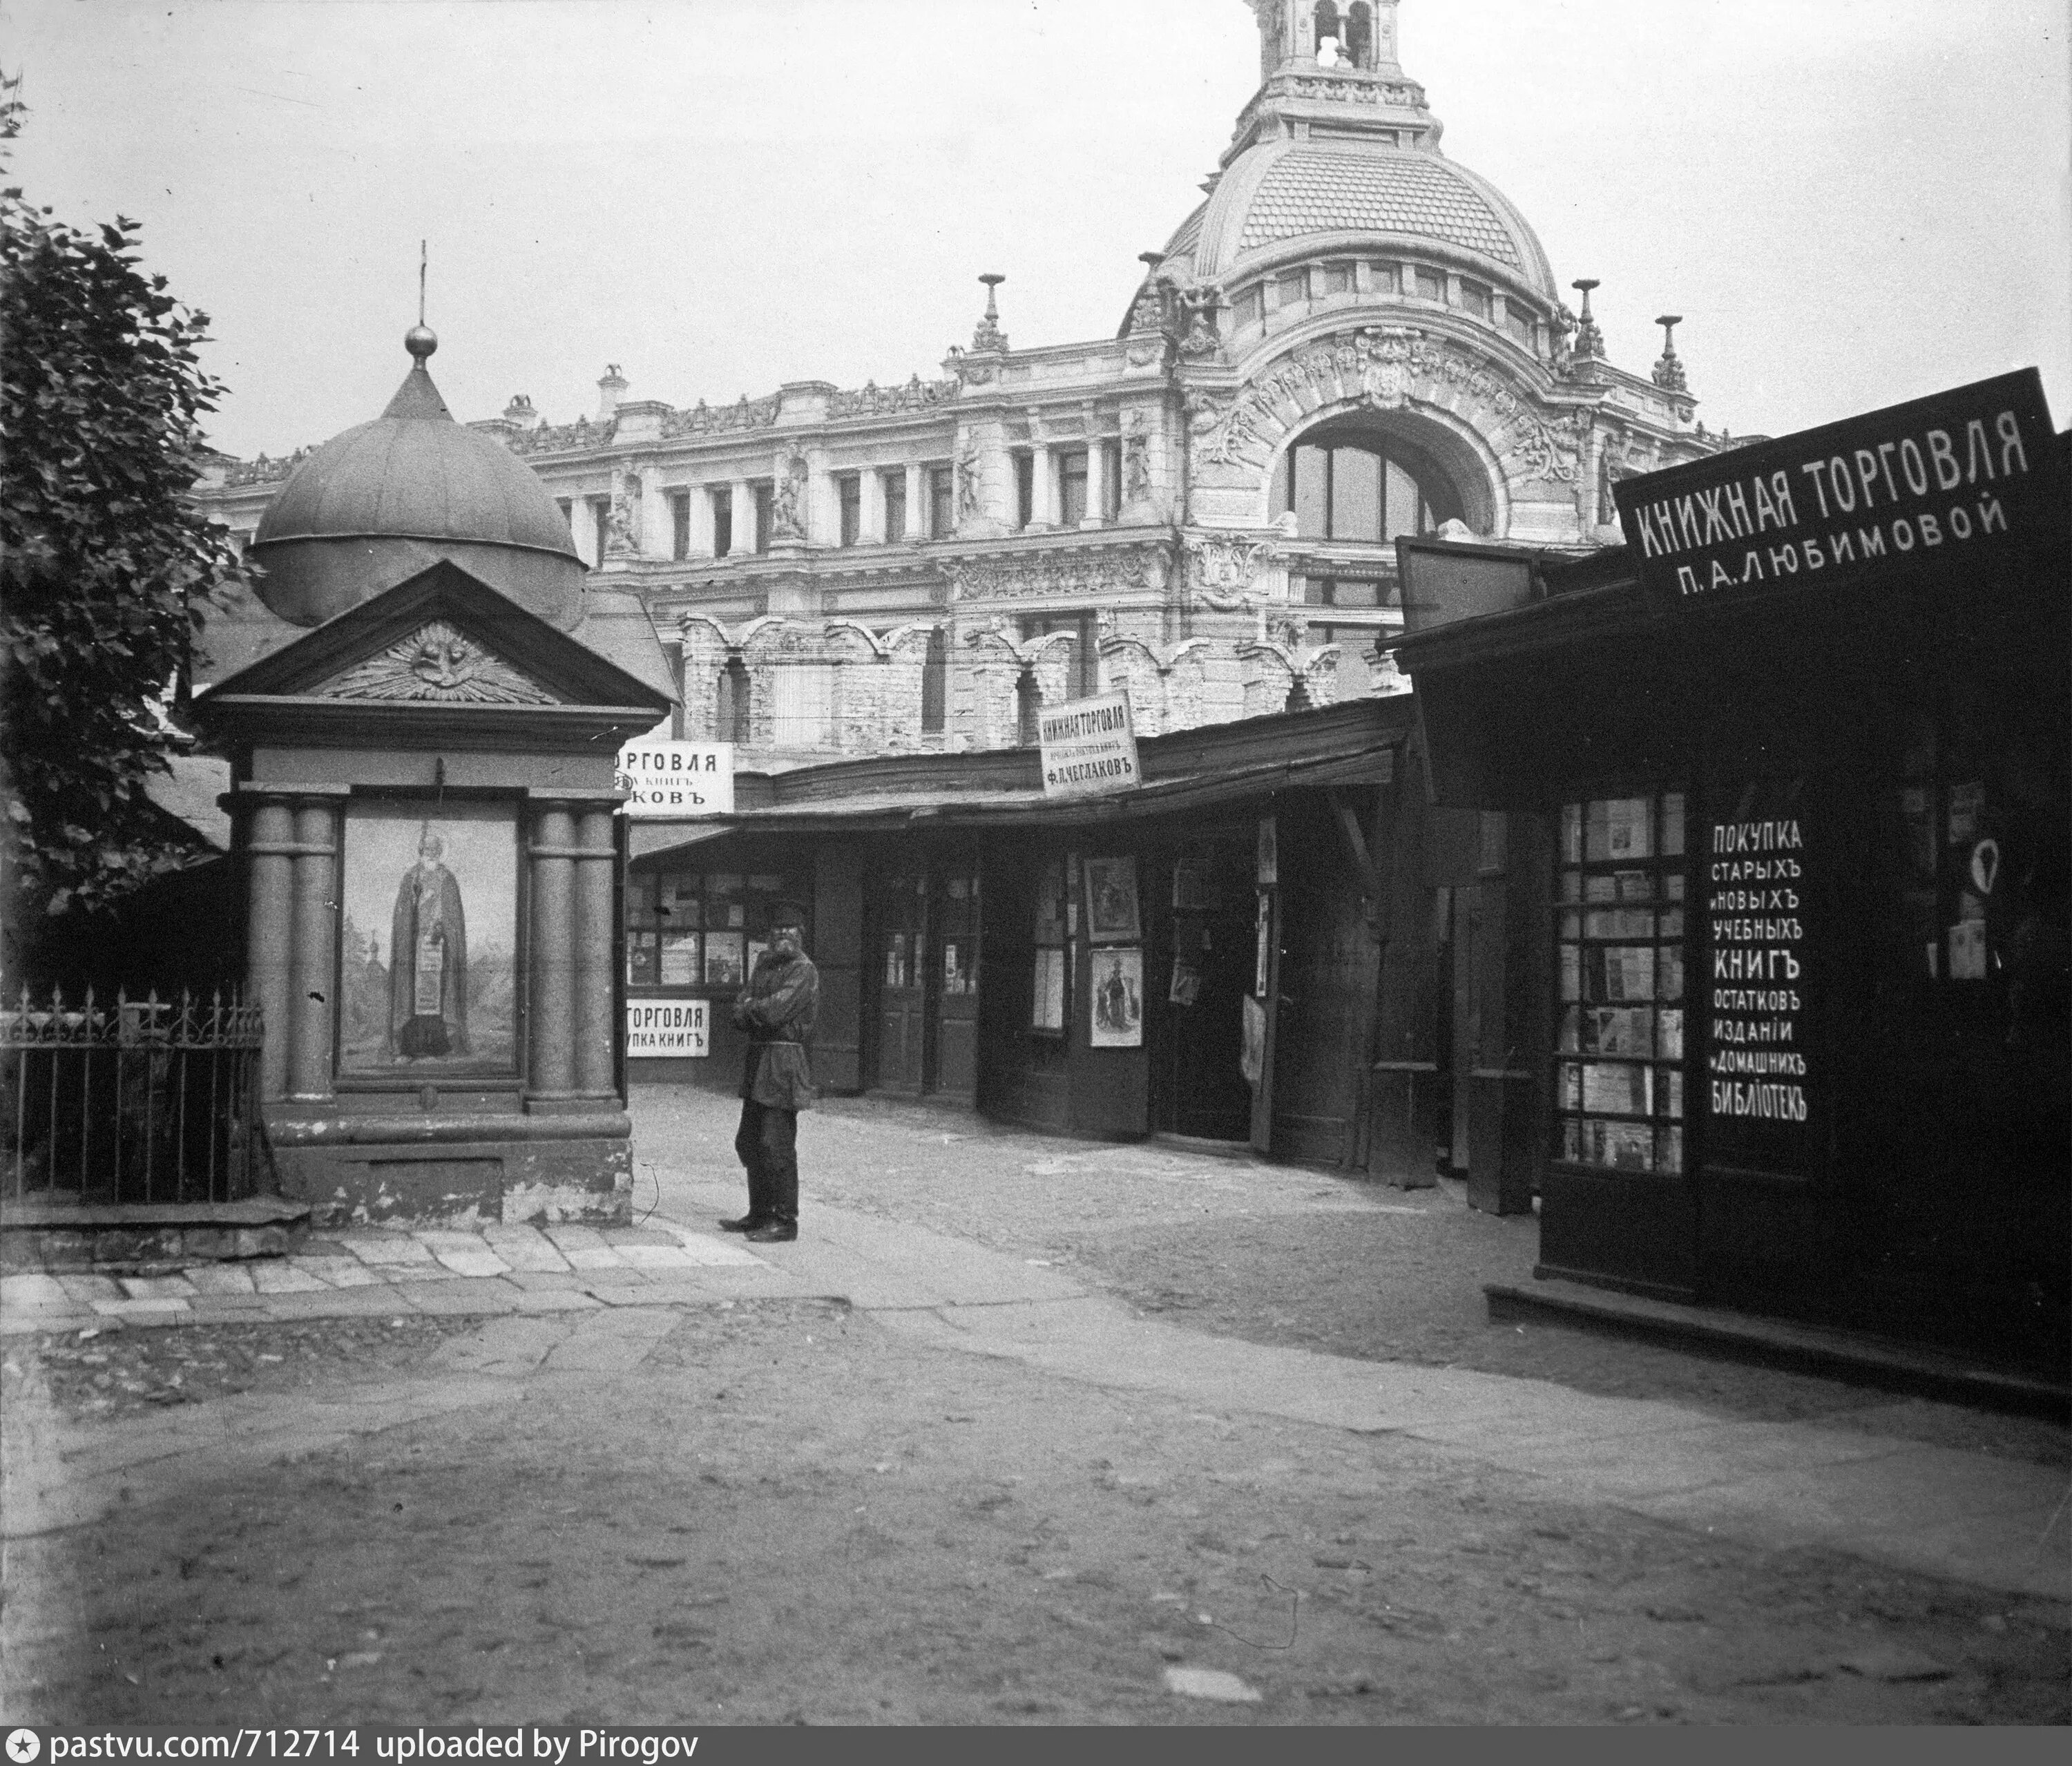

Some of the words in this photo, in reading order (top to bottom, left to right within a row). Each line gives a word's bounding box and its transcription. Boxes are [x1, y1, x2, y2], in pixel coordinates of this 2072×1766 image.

[1635, 470, 1797, 557] КНИЖНАЯ
[1803, 411, 2028, 518] ТОРГОВЛЯ
[1080, 705, 1124, 736] ТОРГОВЛЯ
[631, 791, 704, 804] КОВЪ
[1714, 821, 1802, 853] ПОКУПКА
[1711, 858, 1801, 881] СТАРЫХЪ
[1714, 918, 1803, 940] УЧЕБНЫХЪ
[1715, 949, 1800, 979] КНИГЪ
[1714, 988, 1801, 1010] ОСТАТКОВЪ
[659, 1033, 703, 1047] КНИГЪ
[1712, 1078, 1807, 1121] БИБЛІОТЕКЪ
